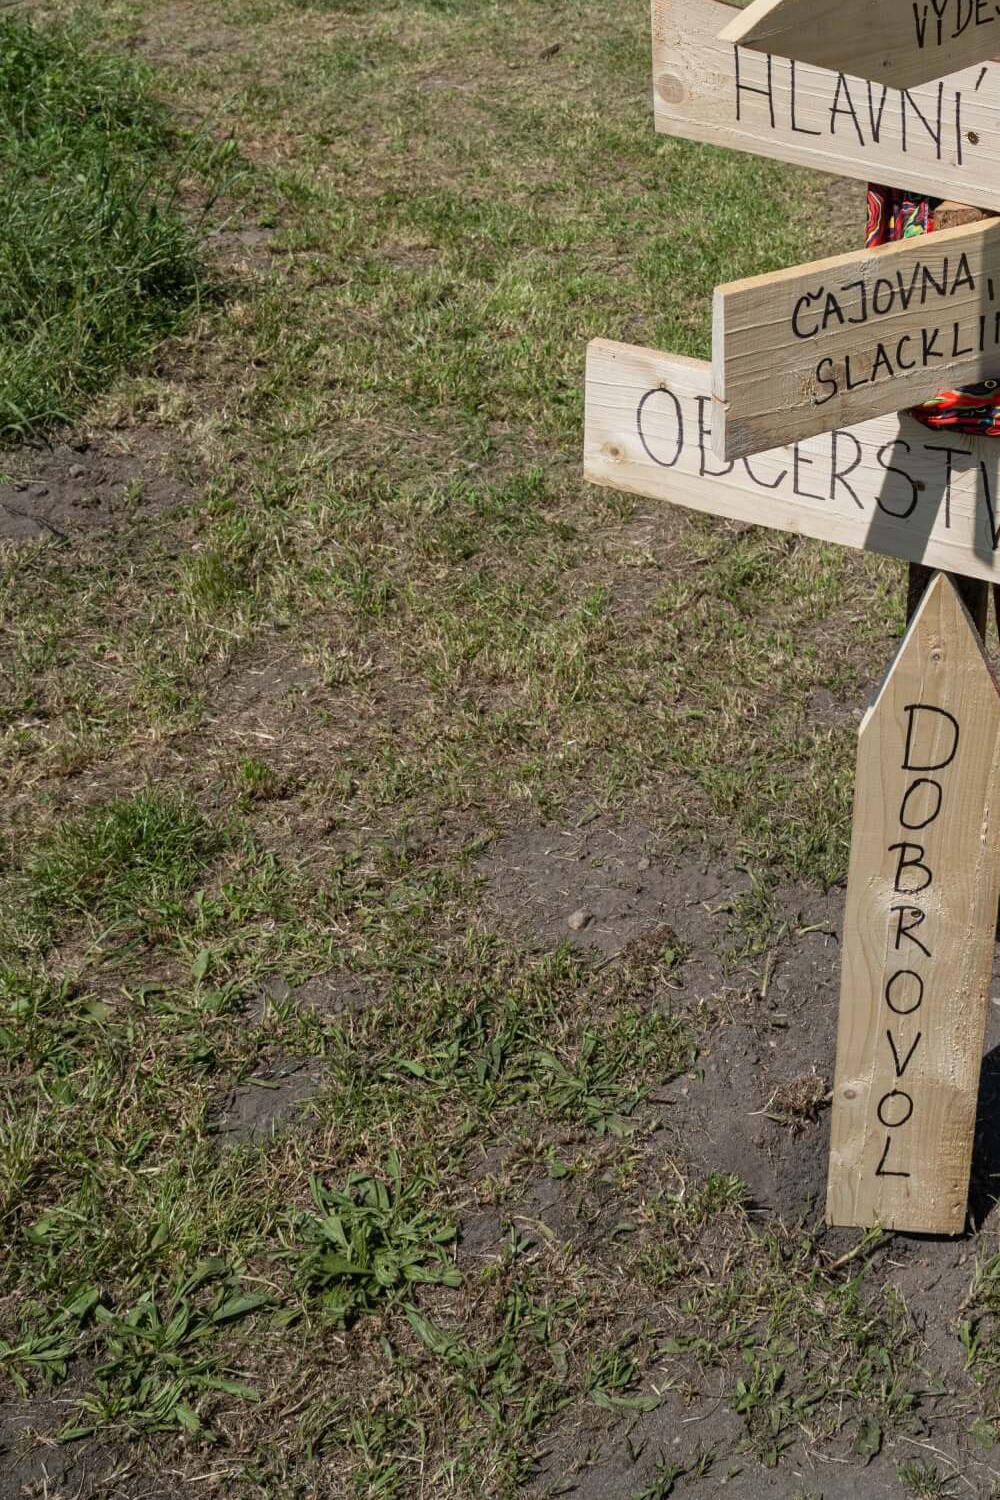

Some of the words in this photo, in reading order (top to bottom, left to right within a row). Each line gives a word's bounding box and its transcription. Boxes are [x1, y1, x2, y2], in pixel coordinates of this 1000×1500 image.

[734, 43, 988, 165] HLAVNÍ
[791, 253, 994, 339] ČAJOVNA,
[875, 704, 960, 1178] DOBROVOL
